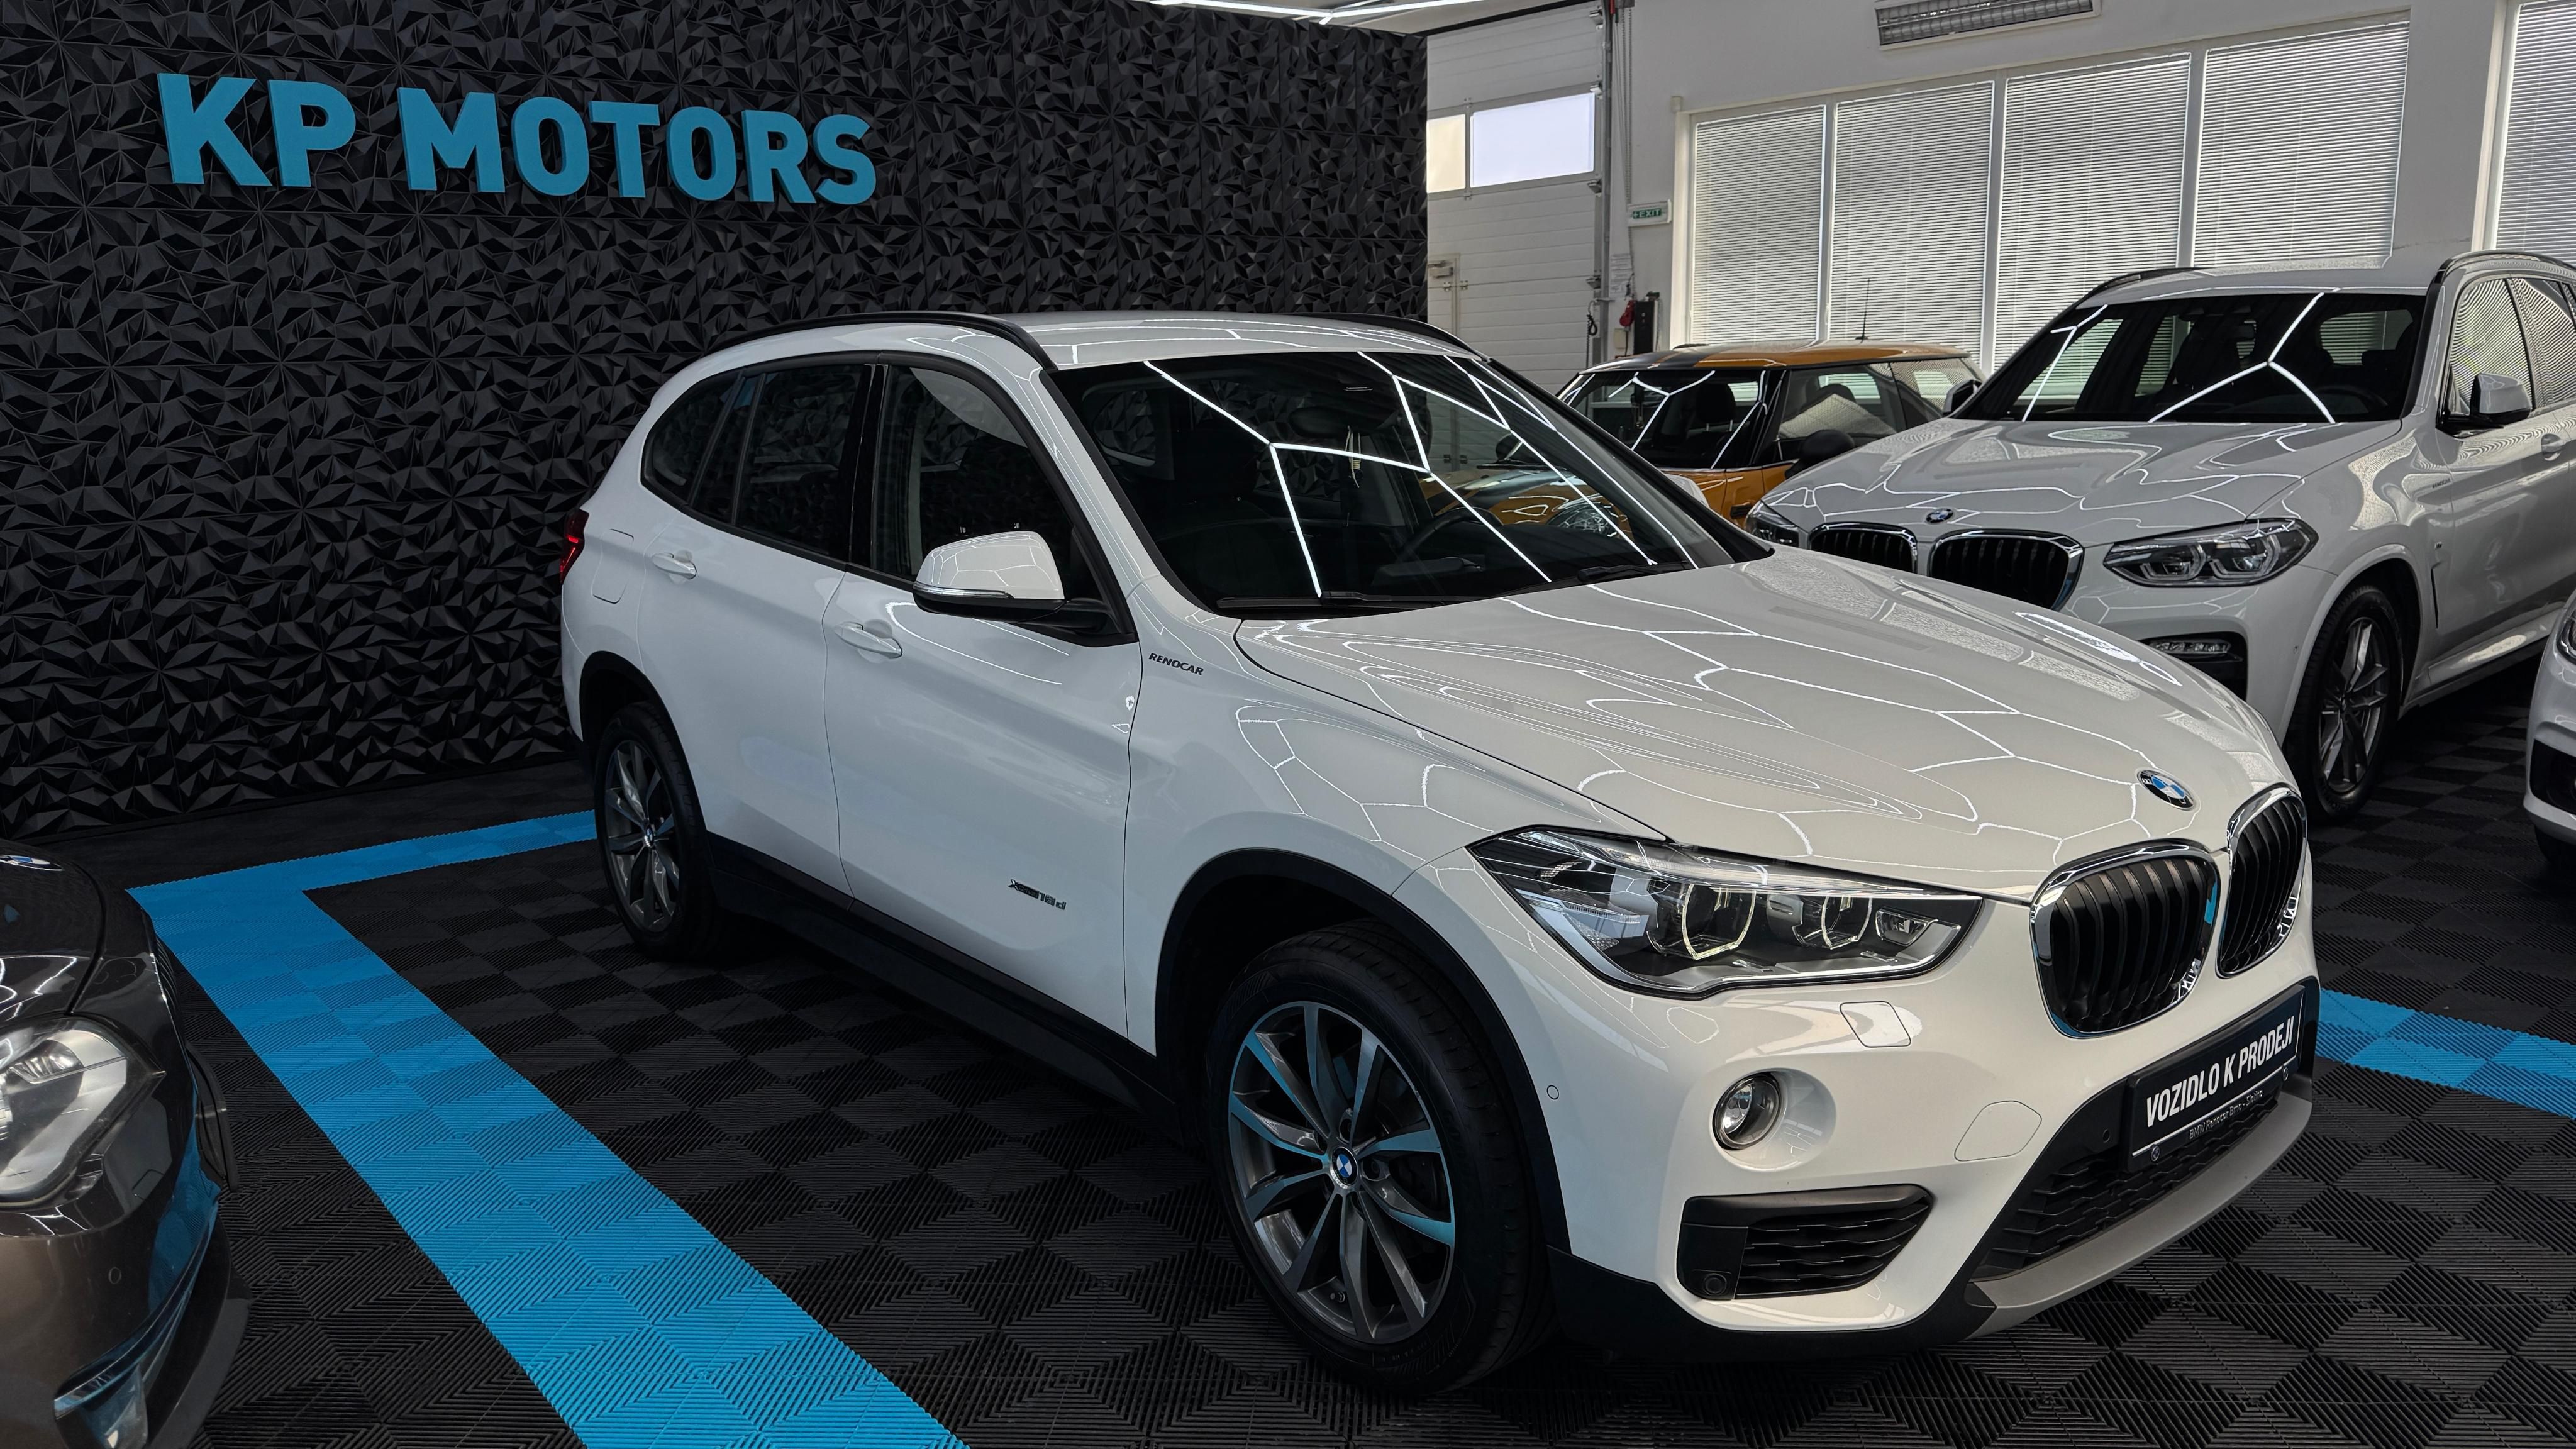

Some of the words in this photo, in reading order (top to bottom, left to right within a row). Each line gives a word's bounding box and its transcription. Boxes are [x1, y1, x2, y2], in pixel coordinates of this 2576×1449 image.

[157, 72, 357, 188] KP
[397, 86, 877, 206] MOTORS
[1639, 209, 1660, 218] EXIT
[1148, 653, 1204, 675] RENOCAR
[2146, 1063, 2219, 1128] VOZIDLO
[2223, 1053, 2236, 1088] K
[2237, 1015, 2295, 1079] PRODEJI
[2189, 1121, 2206, 1140] BMW
